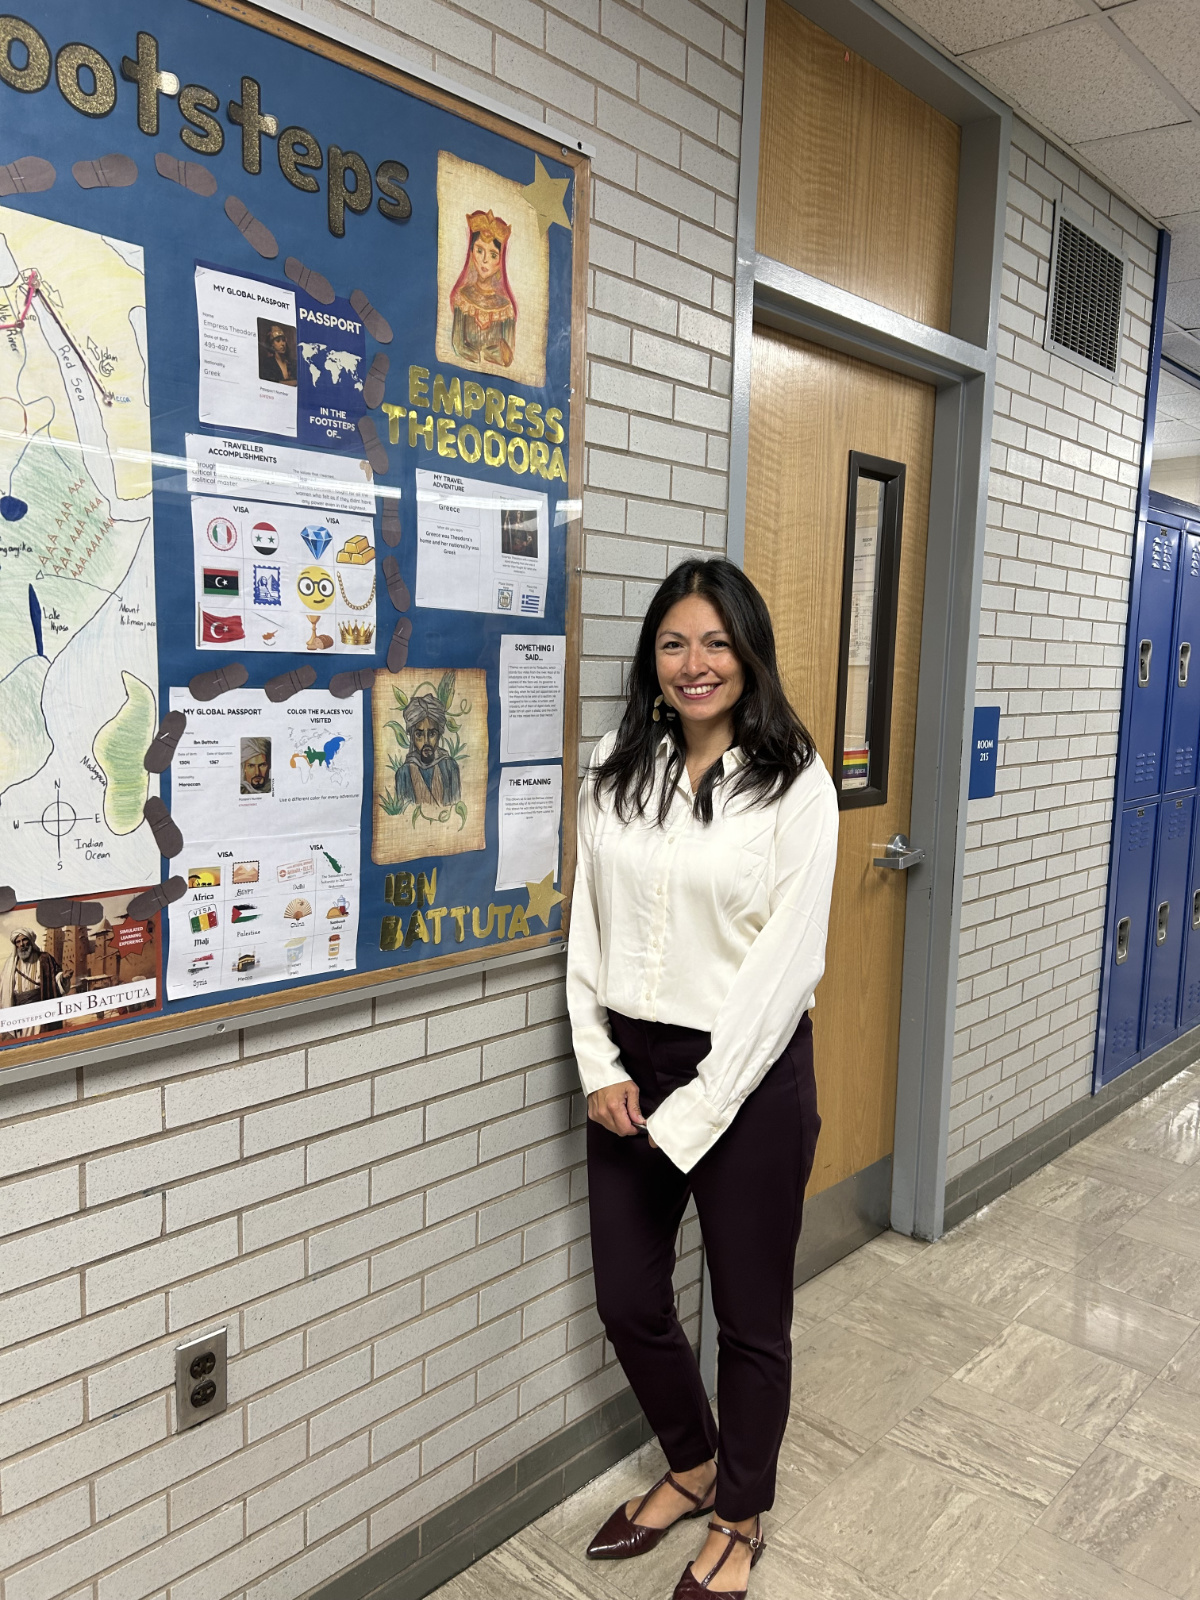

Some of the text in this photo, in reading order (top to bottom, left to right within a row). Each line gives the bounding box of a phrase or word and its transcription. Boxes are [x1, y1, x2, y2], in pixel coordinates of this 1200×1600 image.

[213, 284, 290, 310] MY GLOBAL PASSPORT
[298, 307, 361, 335] PASSPORT
[203, 320, 257, 338] Empress Theodora
[229, 346, 237, 354] CE
[58, 344, 85, 402] Red Sea
[204, 368, 221, 378] Greek
[108, 391, 131, 403] Mecca
[409, 365, 564, 444] EMPRESS
[320, 407, 347, 419] IN THE
[310, 416, 356, 432] FOOTSTEPS
[222, 440, 263, 453] TRAVELLER
[382, 402, 568, 482] THEODORA
[208, 447, 277, 464] ACCOMPLISHMENTS
[433, 474, 463, 485] MY TRAVEL
[432, 481, 465, 493] ADVENTURE
[233, 505, 249, 514] VISA
[438, 503, 461, 514] Greece
[325, 517, 340, 525] VISA
[43, 607, 61, 620] Lake
[119, 603, 140, 614] Mount
[515, 643, 551, 652] SOMETHING
[183, 708, 262, 716] MY GLOBAL PASSPORT
[287, 708, 307, 716] COLOR
[320, 708, 341, 716] PLACES
[341, 708, 354, 716] YOU
[977, 740, 994, 749] ROOM
[980, 752, 989, 762] 215
[55, 778, 61, 789] N
[509, 778, 551, 787] THE MEANING
[95, 813, 100, 823] E
[13, 820, 20, 830] W
[74, 838, 104, 850] Indian
[85, 850, 111, 861] Ocean
[57, 861, 63, 871] S
[384, 867, 437, 909] IBN
[192, 893, 215, 902] Africa
[193, 906, 212, 916] VISA
[119, 926, 144, 935] SIMULATED
[379, 903, 530, 951] BATTUTA
[120, 933, 142, 941] LEARNING
[236, 930, 261, 938] Palestine
[119, 938, 144, 947] EXPERIENCE
[194, 938, 210, 947] Mali
